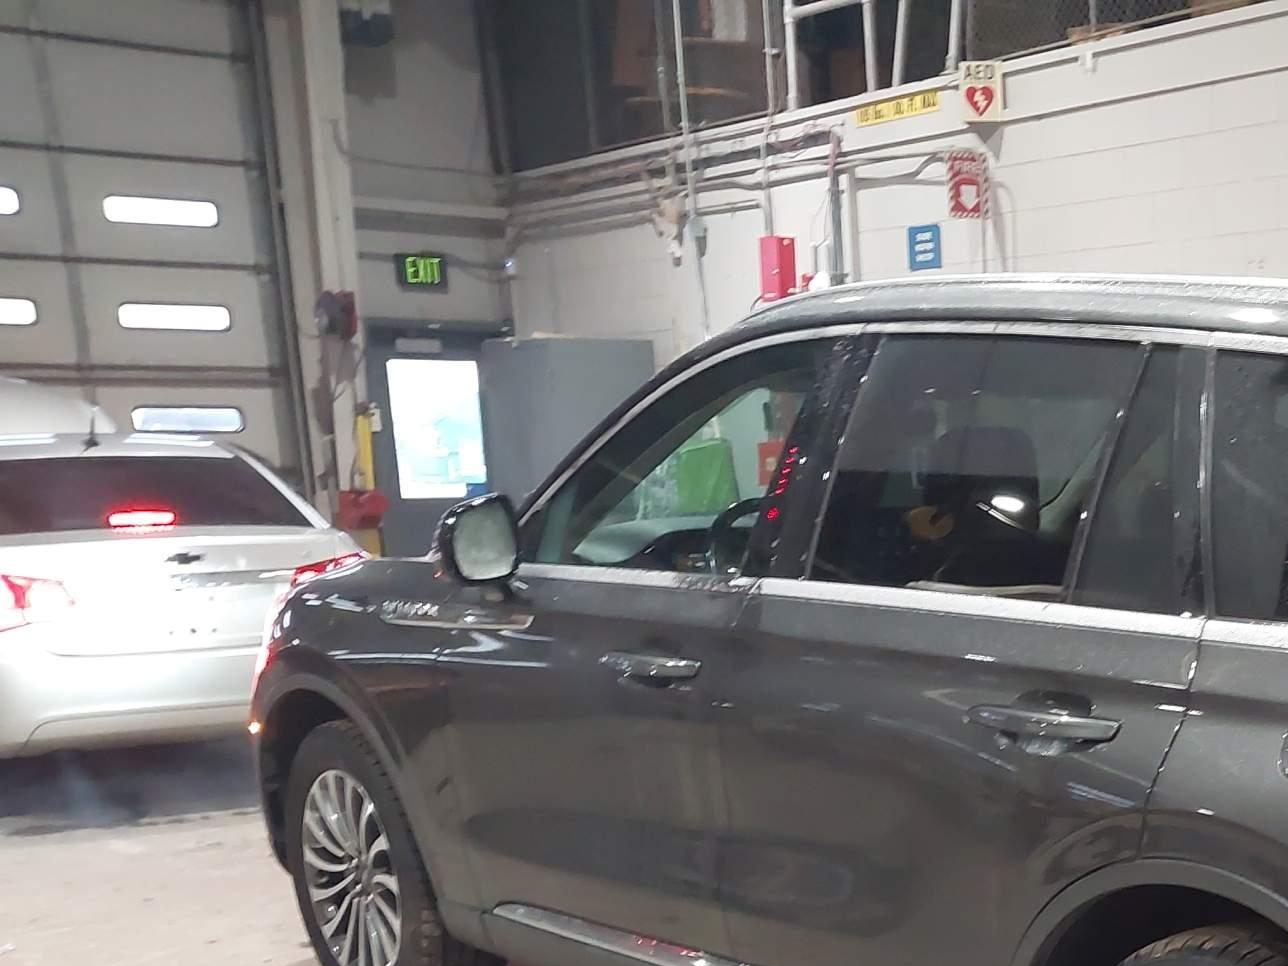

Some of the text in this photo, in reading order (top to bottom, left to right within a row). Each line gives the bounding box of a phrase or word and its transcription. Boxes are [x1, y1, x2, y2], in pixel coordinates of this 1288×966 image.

[964, 64, 995, 80] AED
[954, 160, 981, 174] FIRE
[405, 256, 441, 284] EXIT
